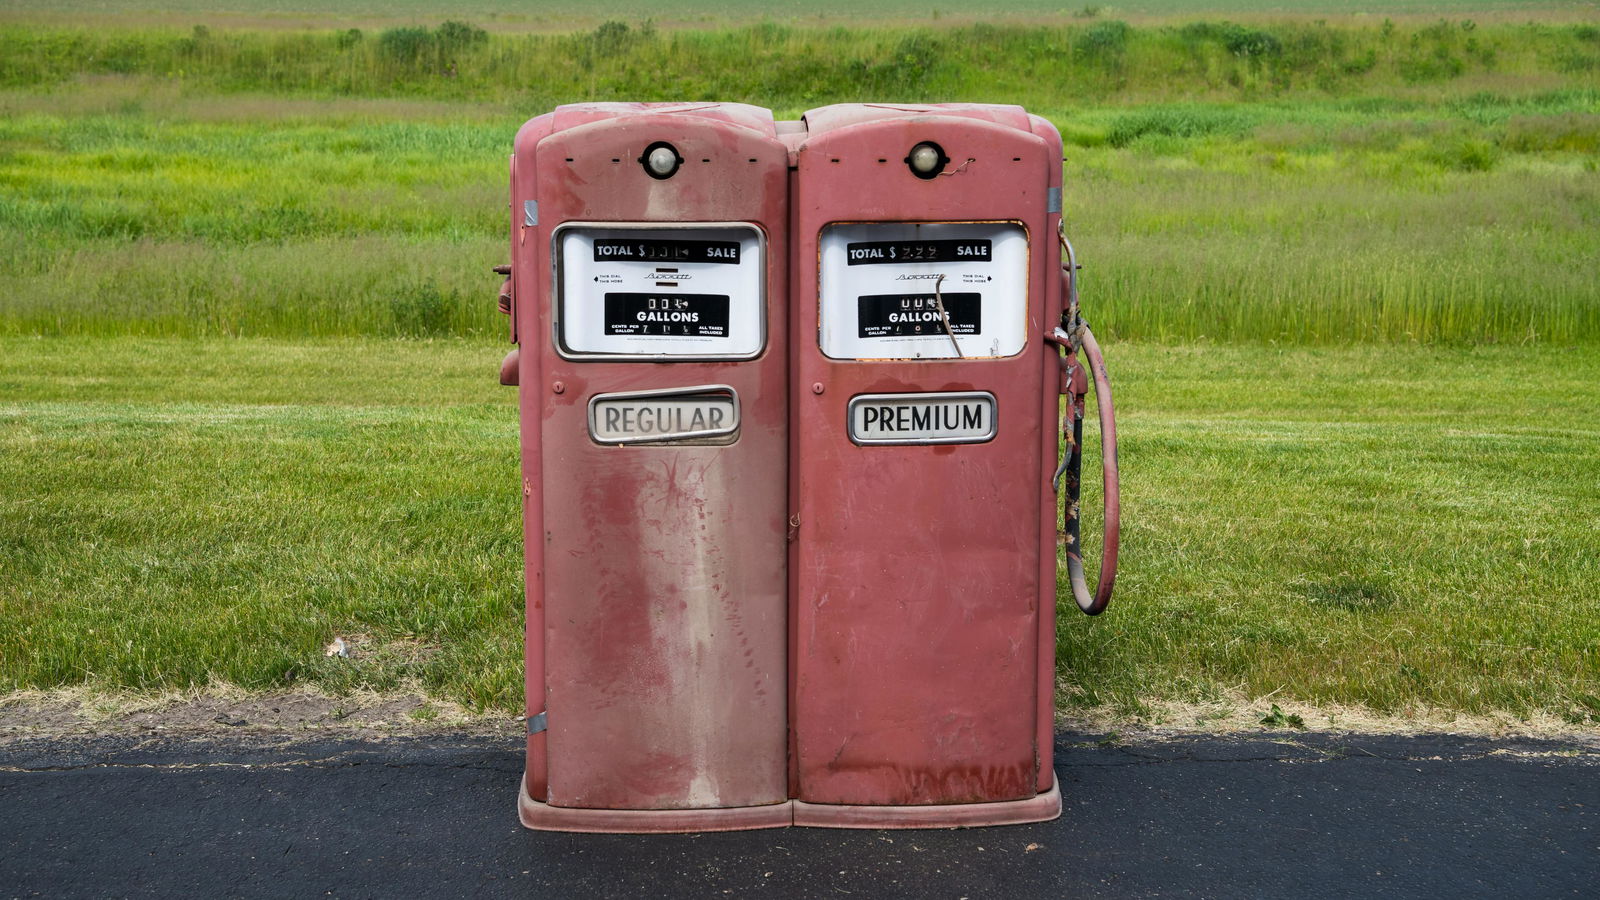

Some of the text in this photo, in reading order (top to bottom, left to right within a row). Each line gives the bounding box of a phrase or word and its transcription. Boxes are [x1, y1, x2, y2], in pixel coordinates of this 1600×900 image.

[597, 245, 633, 256] TOTAL
[706, 247, 736, 259] SALE
[850, 248, 884, 260] TOTAL
[957, 245, 987, 256] SALE
[636, 311, 699, 323] GALLONS
[605, 406, 725, 434] REGULAR
[863, 404, 983, 432] PREMIUM
